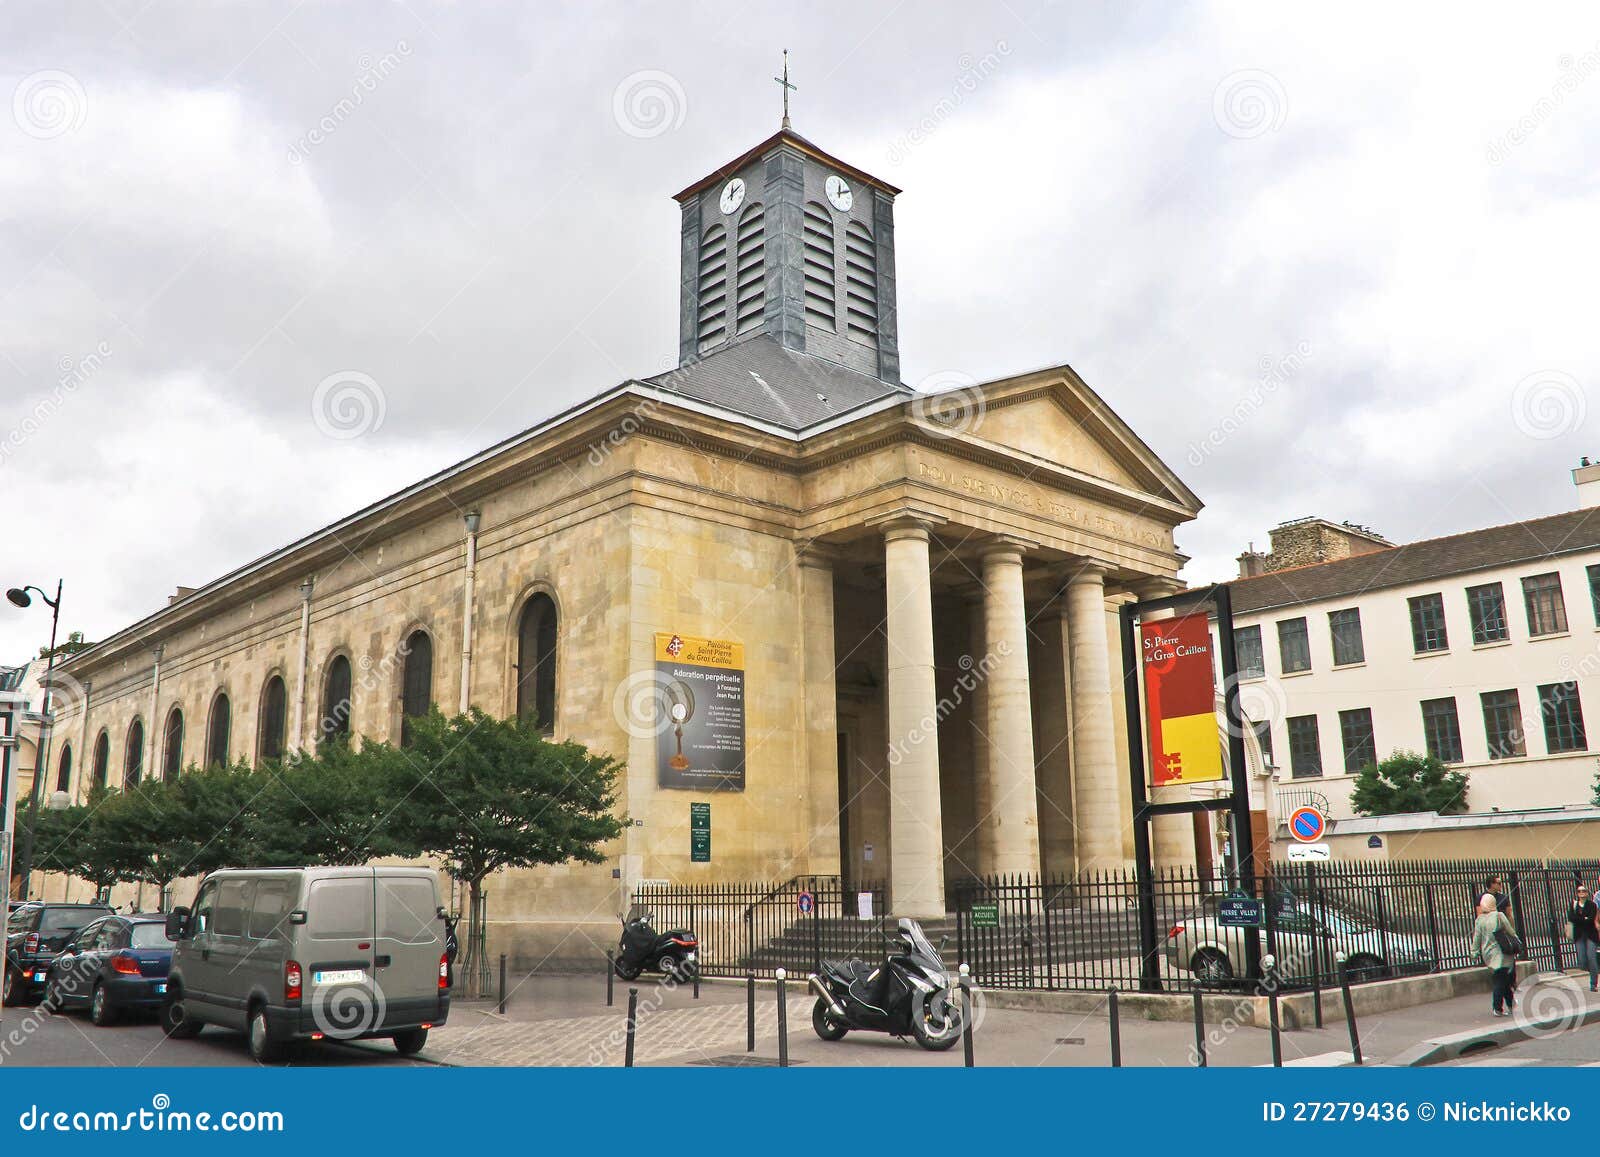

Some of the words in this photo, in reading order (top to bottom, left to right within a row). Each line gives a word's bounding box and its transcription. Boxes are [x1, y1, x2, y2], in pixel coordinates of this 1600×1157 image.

[1155, 636, 1179, 647] Pierre
[698, 647, 713, 655] Saint
[1153, 649, 1175, 661] Gros
[1176, 645, 1207, 657] Caillou
[673, 669, 705, 680] Adoration
[705, 671, 741, 684] perpétuelle
[974, 911, 995, 919] ACCUEIL
[1221, 909, 1237, 917] PIERRE
[1239, 909, 1258, 917] VILLEY
